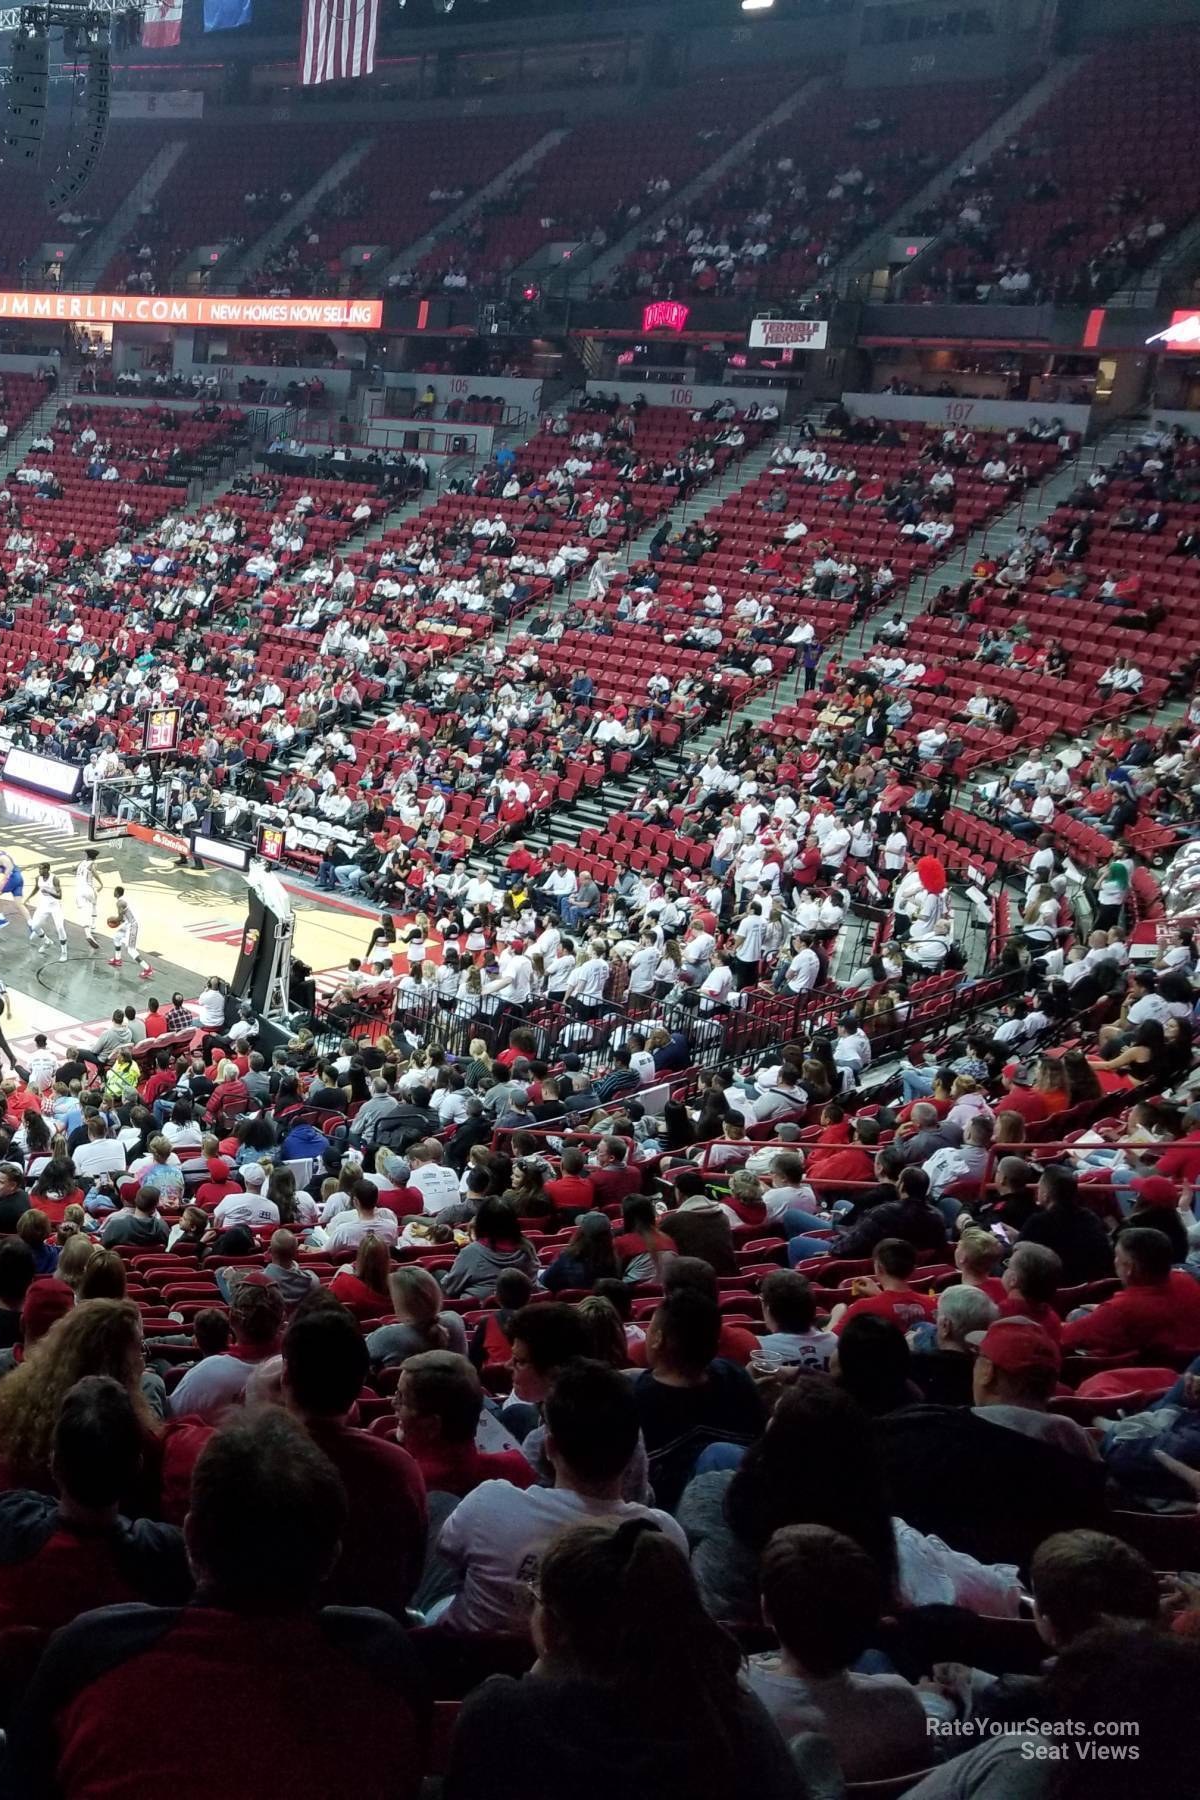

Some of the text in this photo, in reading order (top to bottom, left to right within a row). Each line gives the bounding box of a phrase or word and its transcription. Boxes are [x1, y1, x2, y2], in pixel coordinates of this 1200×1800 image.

[211, 304, 371, 322] NEW HOMES NOW SELLING
[761, 321, 820, 334] TERRIBLE
[764, 333, 814, 345] HERBST
[217, 367, 234, 380] 104
[451, 379, 469, 393] 105
[671, 389, 693, 404] 106
[945, 404, 974, 419] 107
[264, 840, 277, 855] 30
